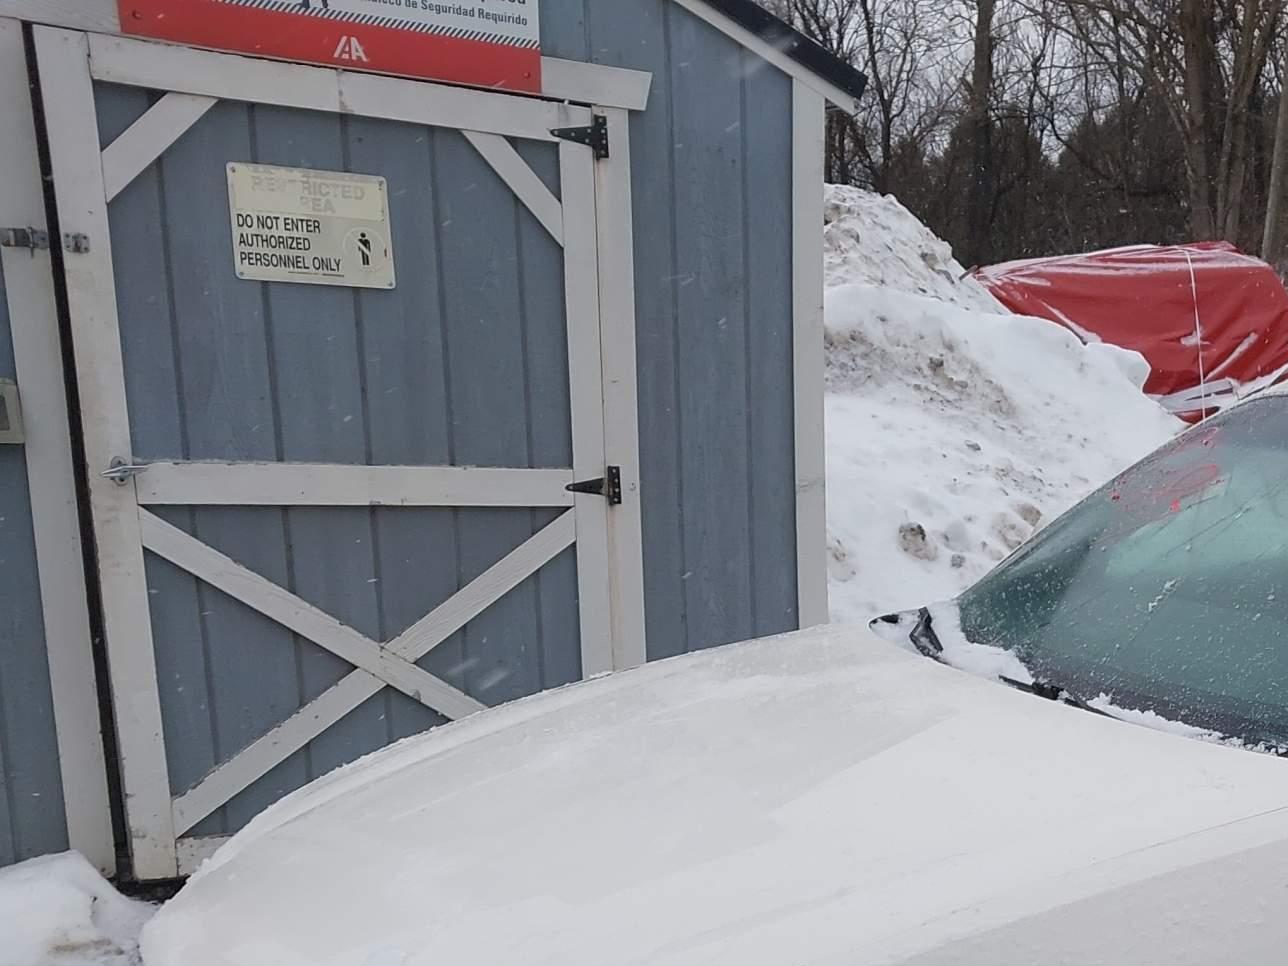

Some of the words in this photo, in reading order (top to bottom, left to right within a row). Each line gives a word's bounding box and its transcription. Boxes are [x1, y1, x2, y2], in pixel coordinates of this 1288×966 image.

[421, 0, 474, 17] Seguridad
[478, 8, 527, 26] Requirido
[236, 213, 253, 228] DO
[256, 215, 280, 230] NOT
[283, 218, 321, 233] ENTER
[238, 233, 311, 251] AUTHORIZED
[239, 251, 310, 270] PERSONNEL
[312, 256, 341, 272] ONLY
